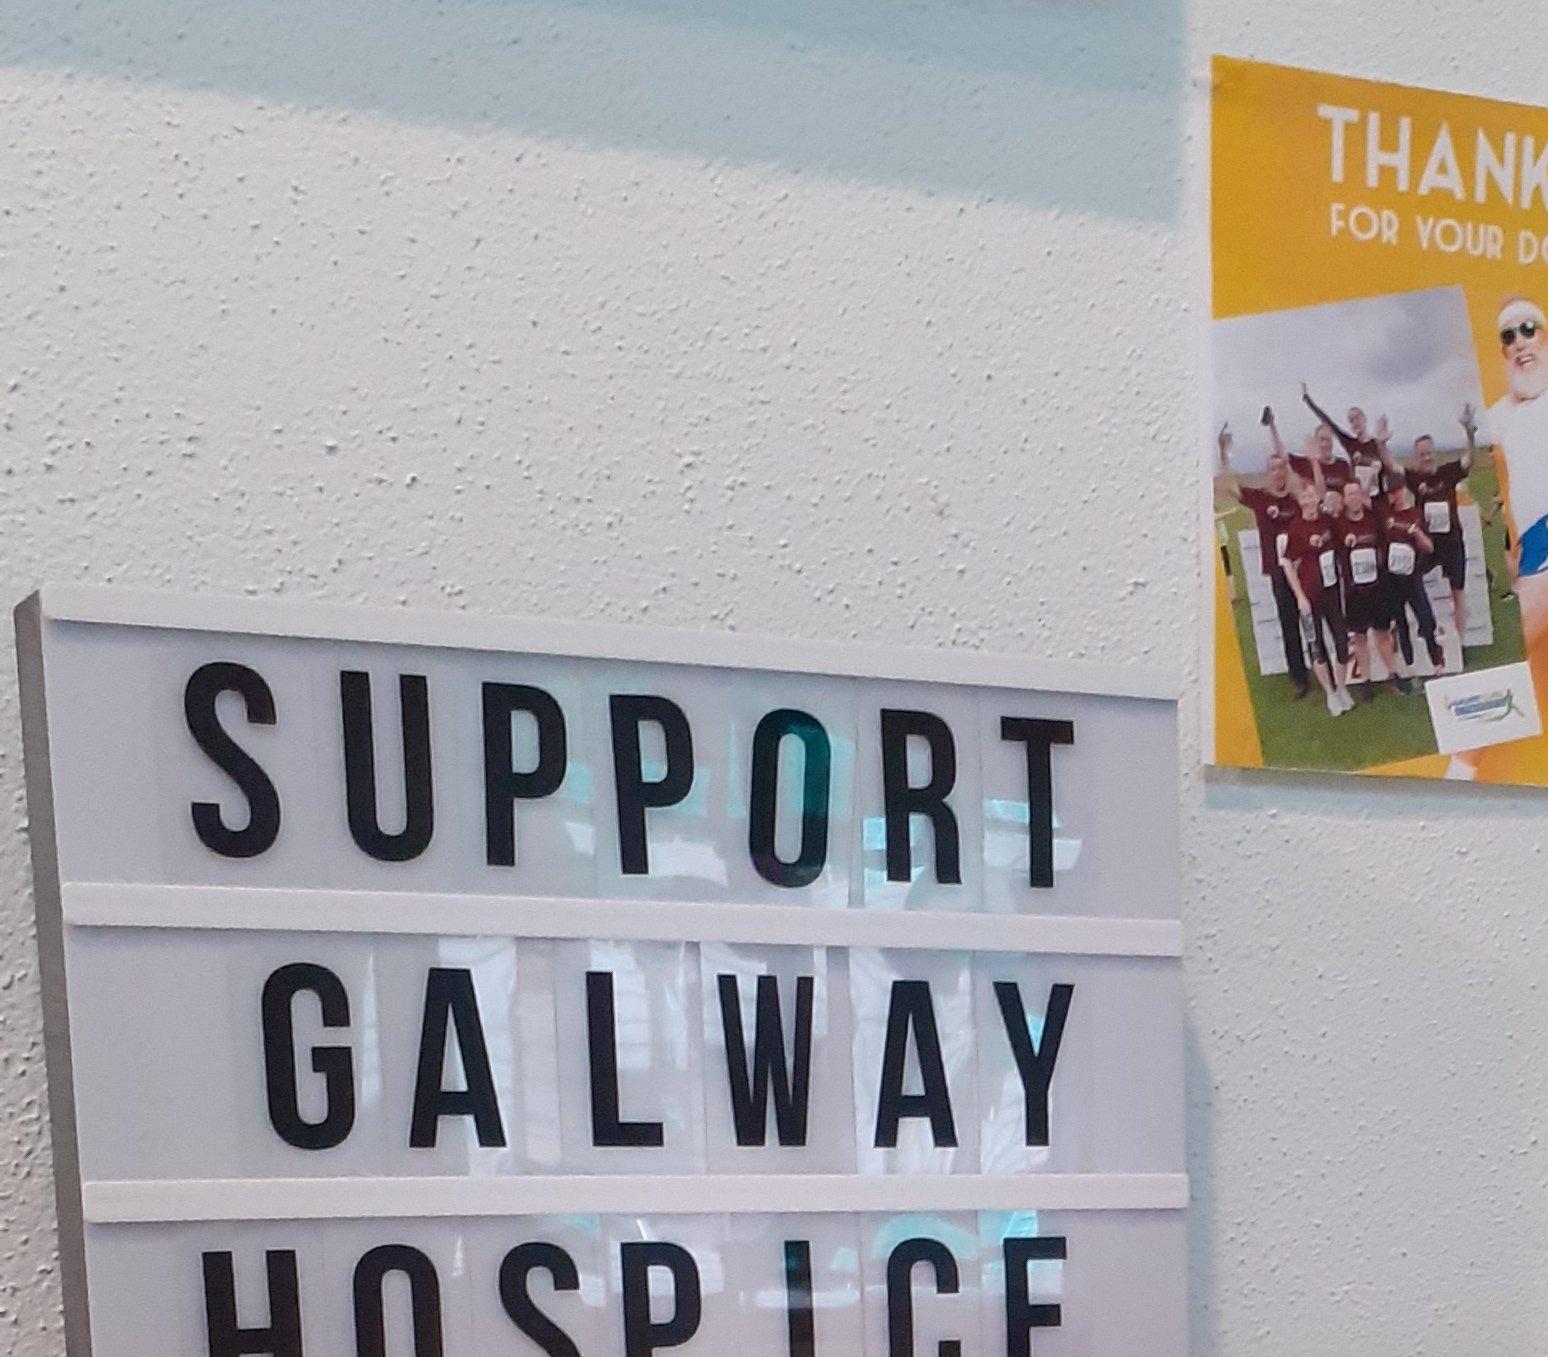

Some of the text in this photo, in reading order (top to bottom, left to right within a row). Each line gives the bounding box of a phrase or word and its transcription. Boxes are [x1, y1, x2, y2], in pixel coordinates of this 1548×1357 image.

[1330, 203, 1398, 245] FOR
[1416, 215, 1504, 260] YOUR
[183, 661, 1076, 889] SUPPORT
[260, 962, 1076, 1152] GALWAY
